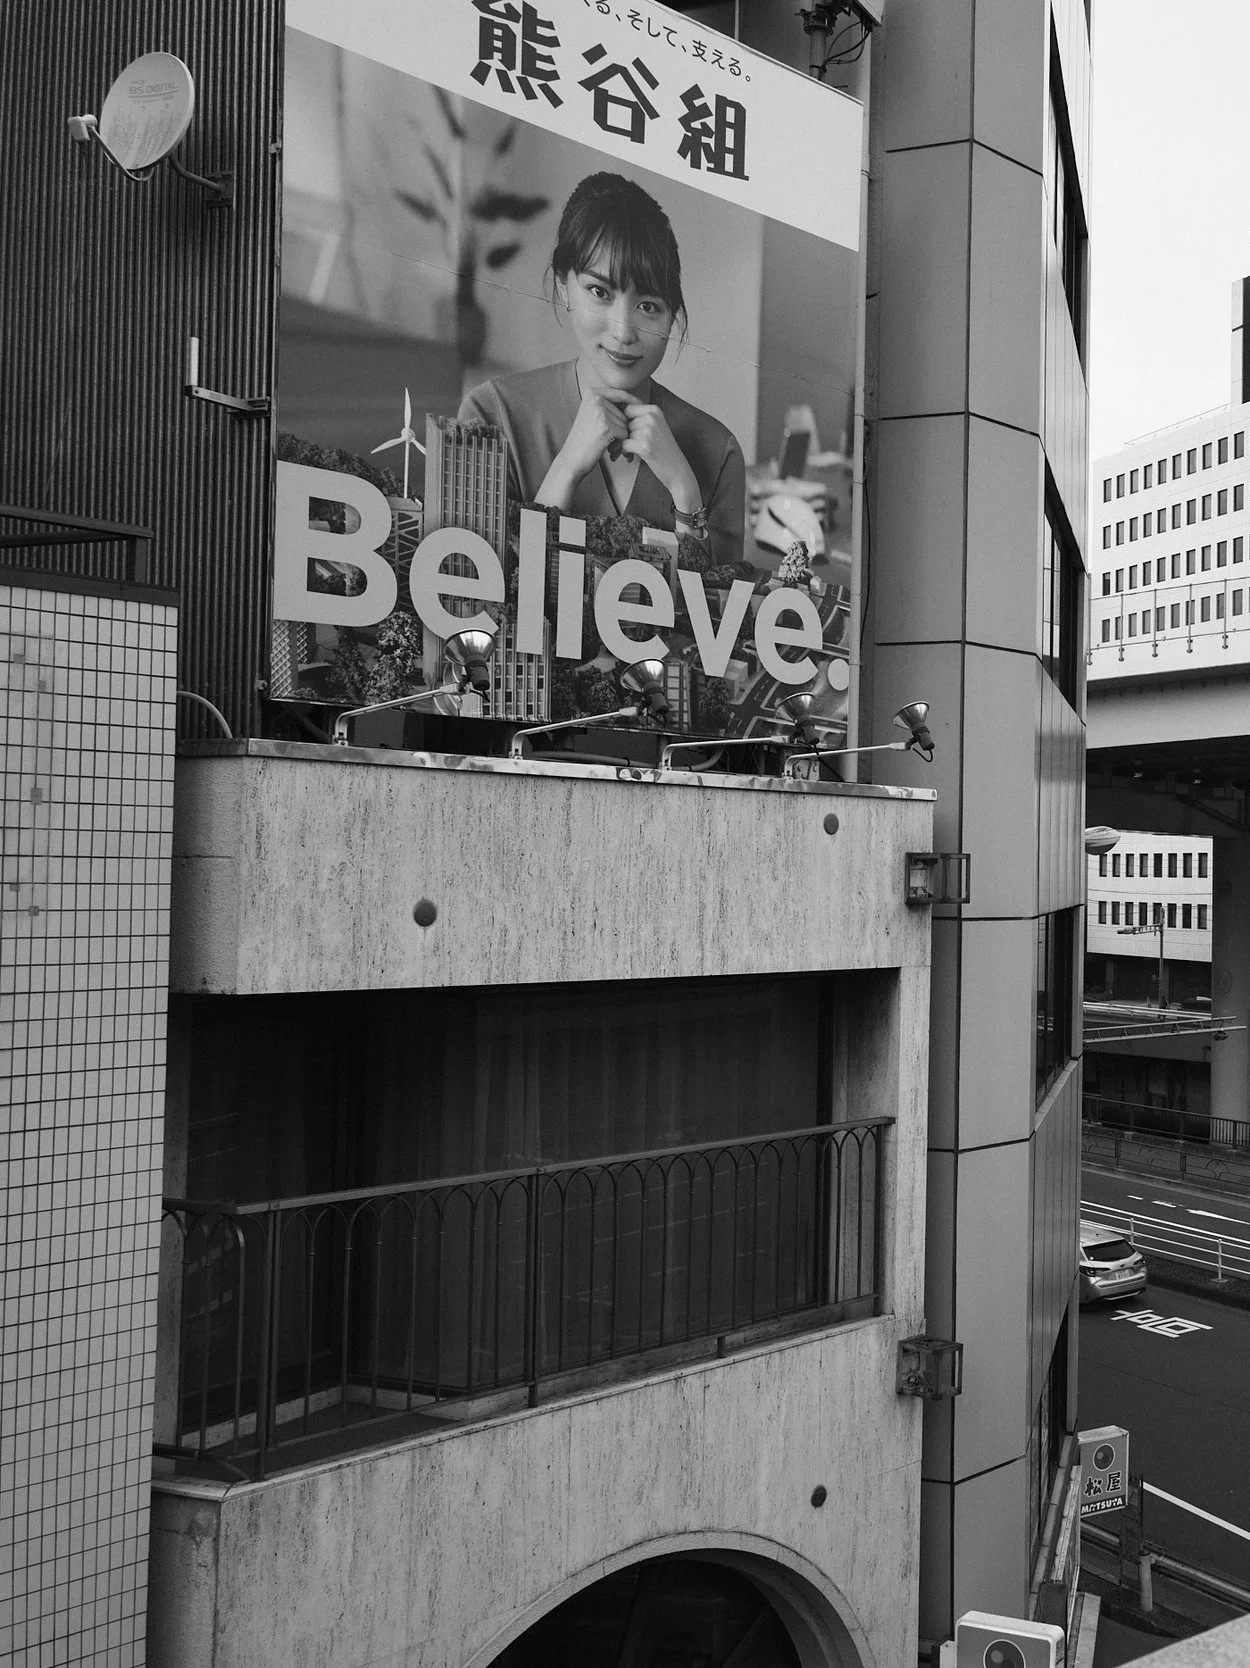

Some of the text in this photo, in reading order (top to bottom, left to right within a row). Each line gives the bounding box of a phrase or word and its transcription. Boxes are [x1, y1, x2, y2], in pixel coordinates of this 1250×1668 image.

[584, 0, 751, 82] る、そして、支える。
[469, 0, 750, 182] 熊谷組
[272, 459, 852, 692] Believe.
[1109, 1309, 1214, 1338] 高
[1081, 1497, 1123, 1514] MATSUYA
[1083, 1470, 1121, 1498] 松屋
